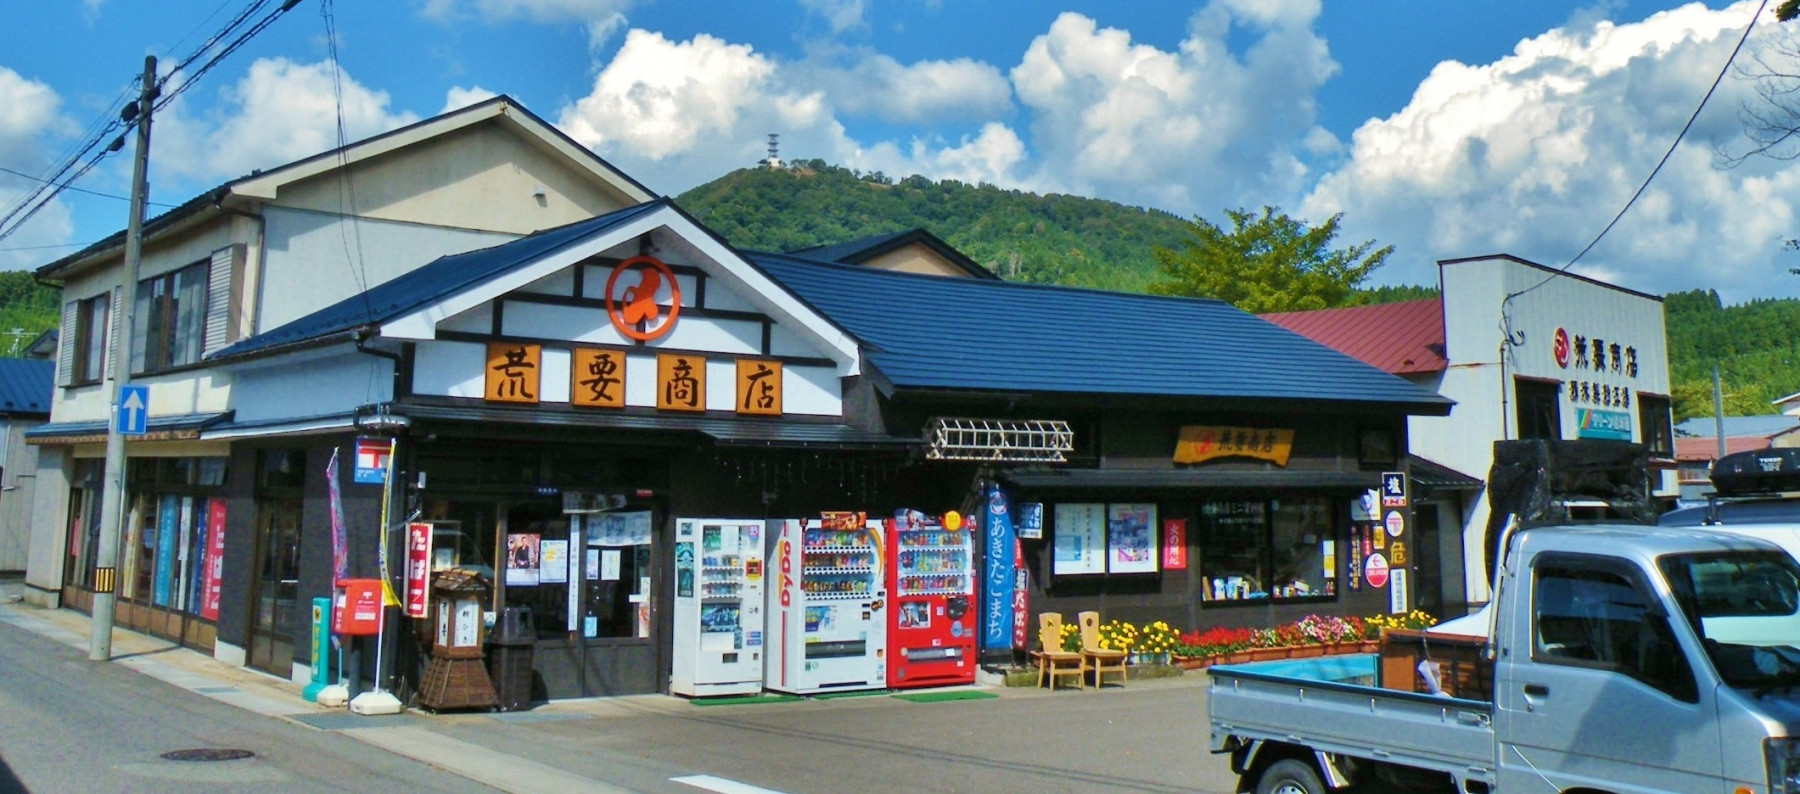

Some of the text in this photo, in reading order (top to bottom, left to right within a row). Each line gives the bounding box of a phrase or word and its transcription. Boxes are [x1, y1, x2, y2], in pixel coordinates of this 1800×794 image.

[493, 347, 774, 410] 荒要商店
[1387, 476, 1402, 494] 塩
[1169, 523, 1180, 566] 火の用心
[1391, 541, 1406, 565] 危
[781, 541, 793, 607] DyDo
[989, 516, 1005, 639] あきたこまち
